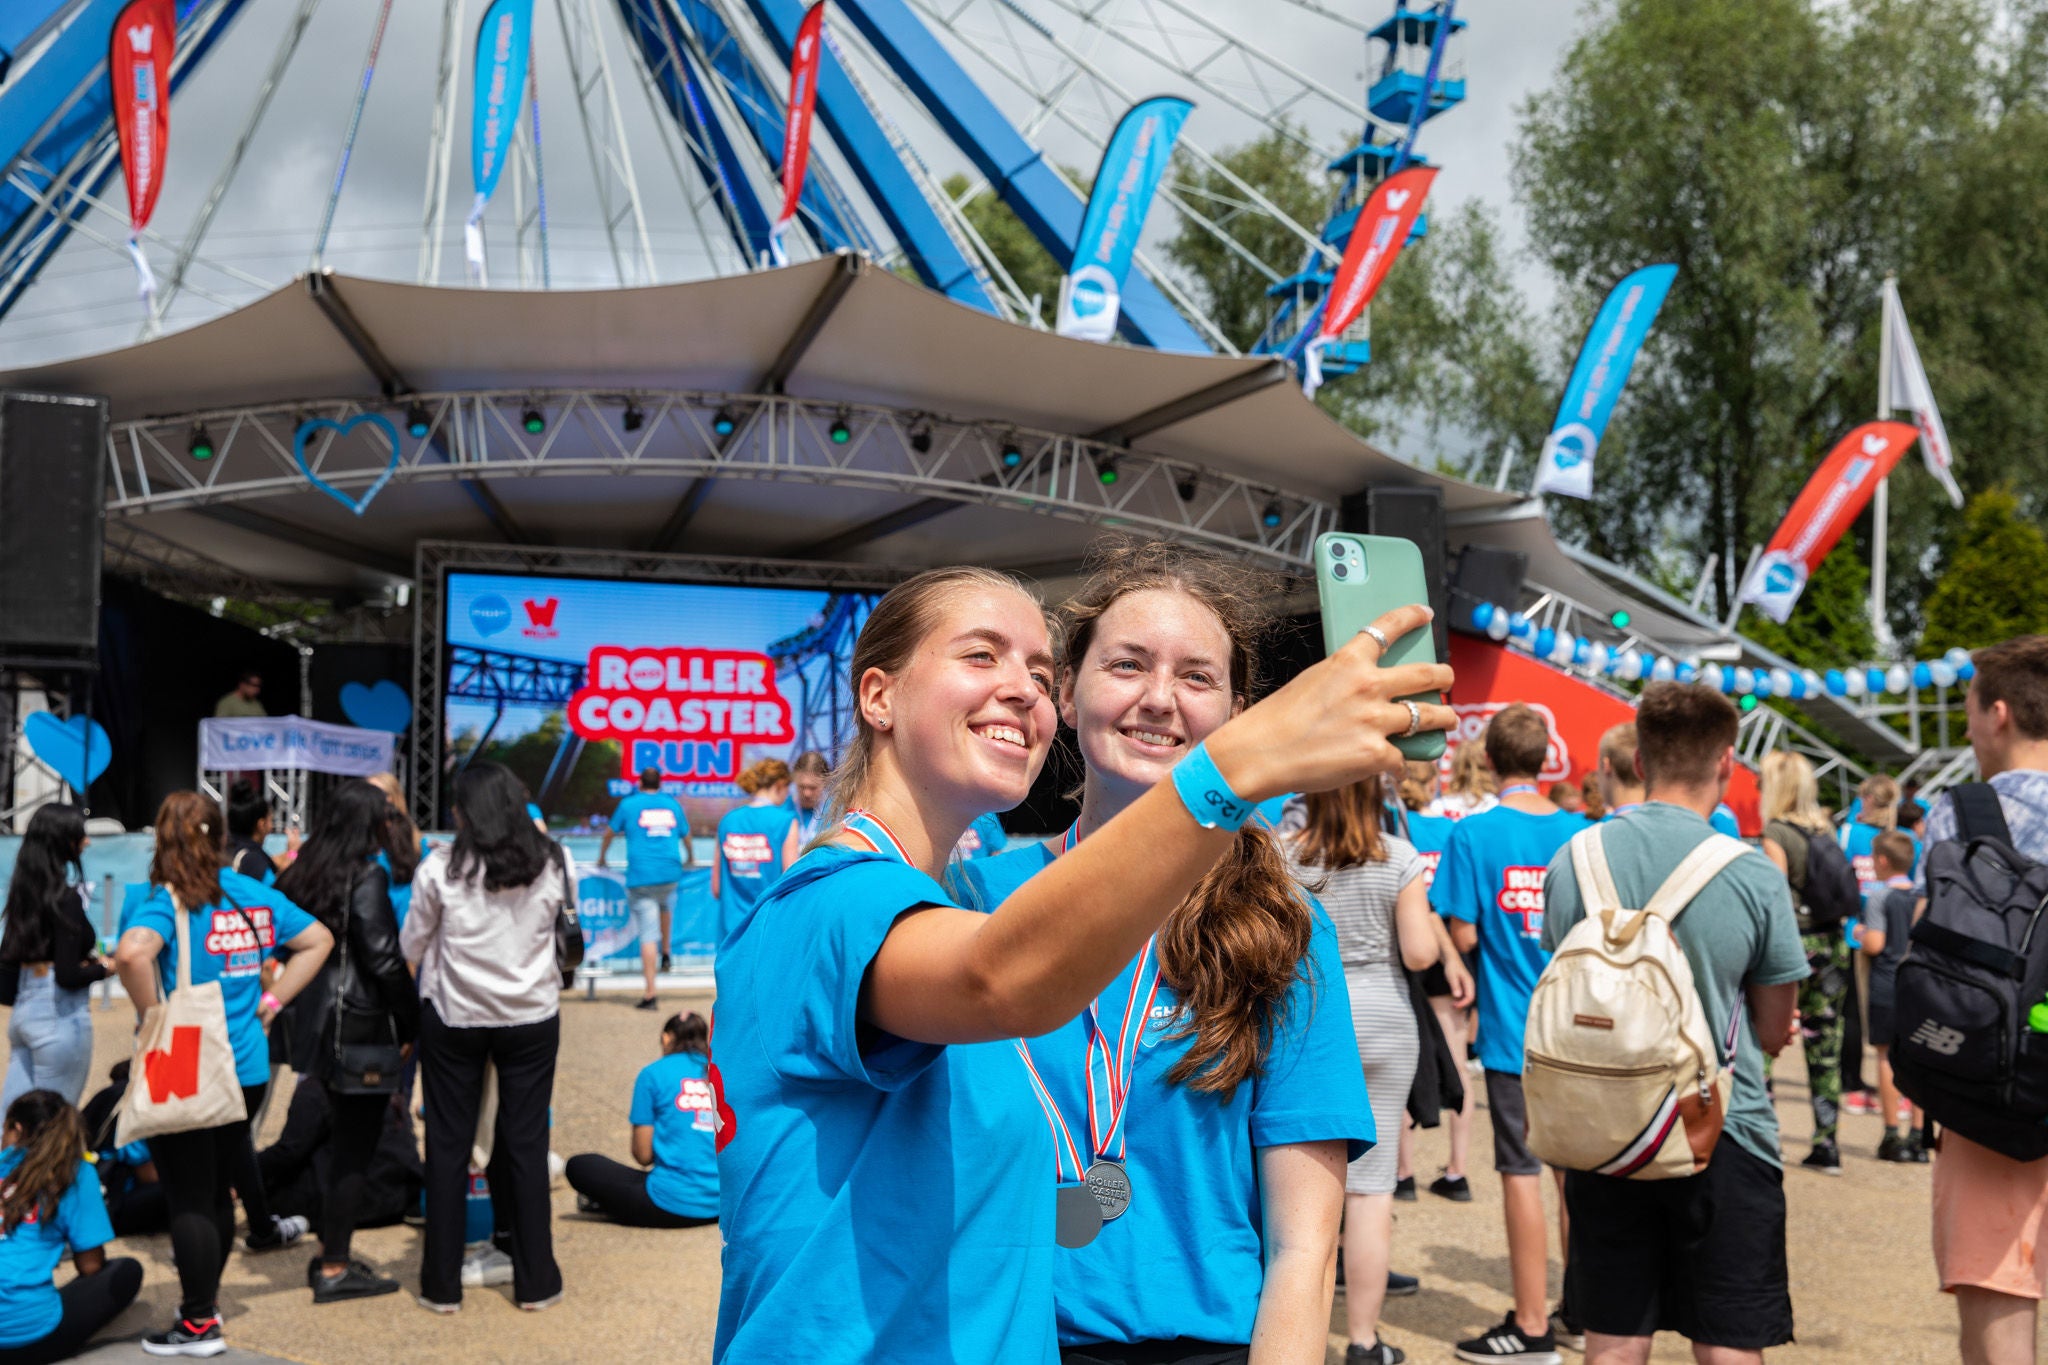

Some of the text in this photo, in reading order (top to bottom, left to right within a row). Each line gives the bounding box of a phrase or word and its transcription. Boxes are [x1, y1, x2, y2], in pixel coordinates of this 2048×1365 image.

[599, 655, 767, 695] ROLLER
[578, 695, 784, 736] COASTER
[223, 732, 275, 751] Love
[633, 739, 733, 777] RUN
[608, 779, 633, 796] TO
[1089, 1174, 1125, 1191] ROLLER
